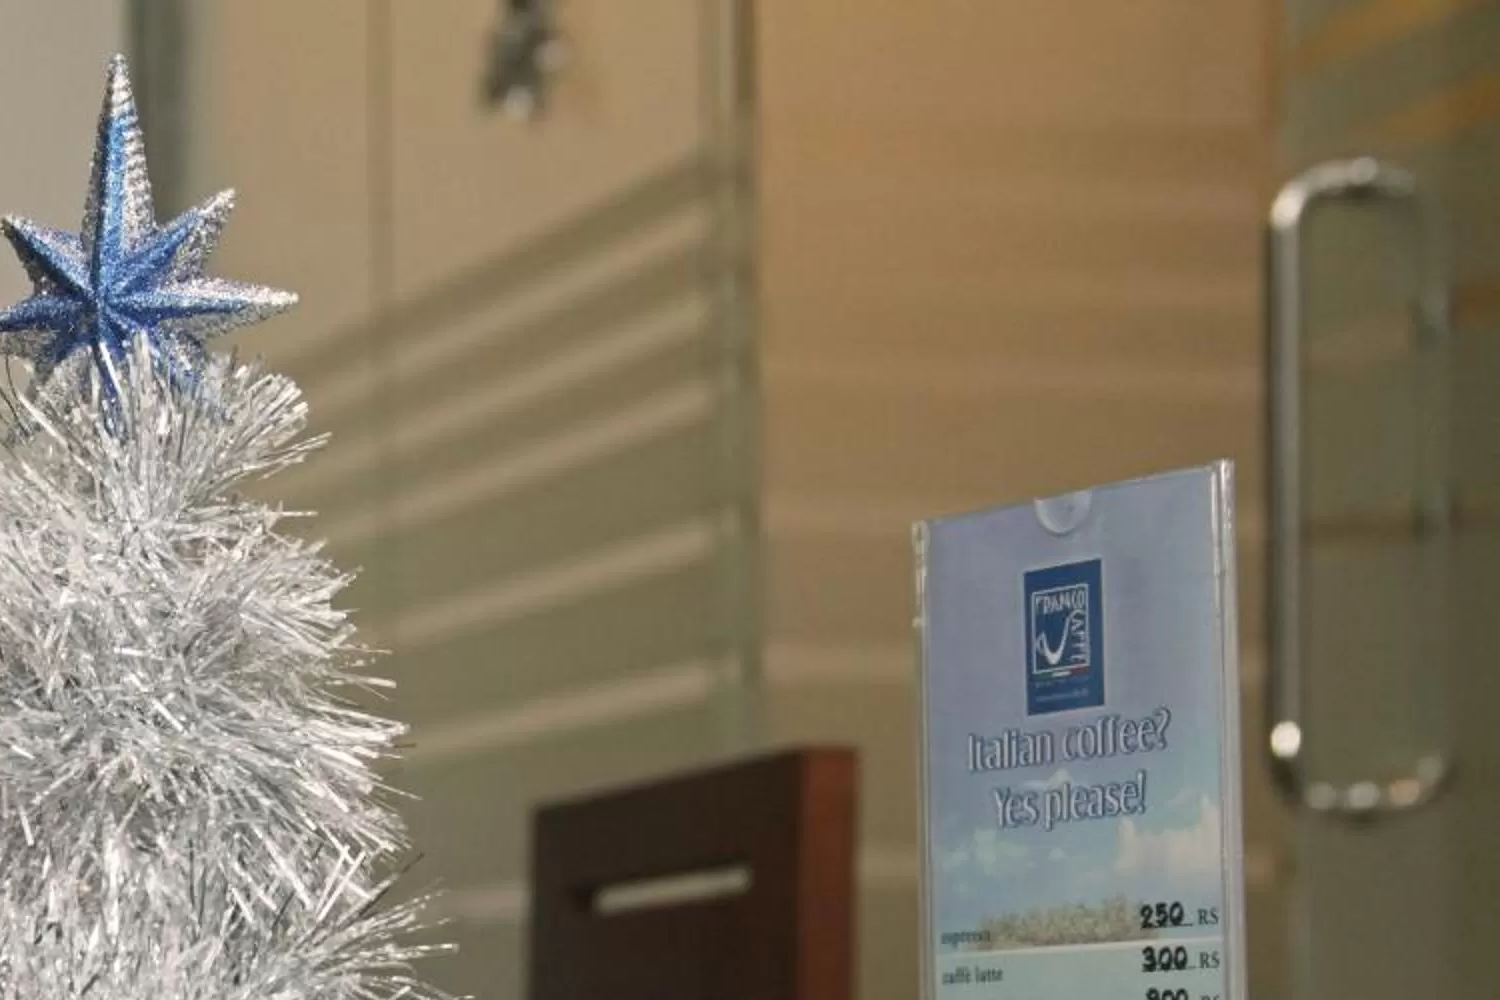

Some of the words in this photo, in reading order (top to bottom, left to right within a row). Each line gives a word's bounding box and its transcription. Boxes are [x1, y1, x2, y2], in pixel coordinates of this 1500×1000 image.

[968, 731, 1055, 771] Italian
[1061, 706, 1172, 762] coffee?
[992, 786, 1039, 829] Yes
[1042, 769, 1148, 831] please!
[1140, 901, 1184, 928] 250
[1198, 907, 1219, 925] RS
[1142, 945, 1188, 973] 300
[1199, 951, 1221, 969] RS
